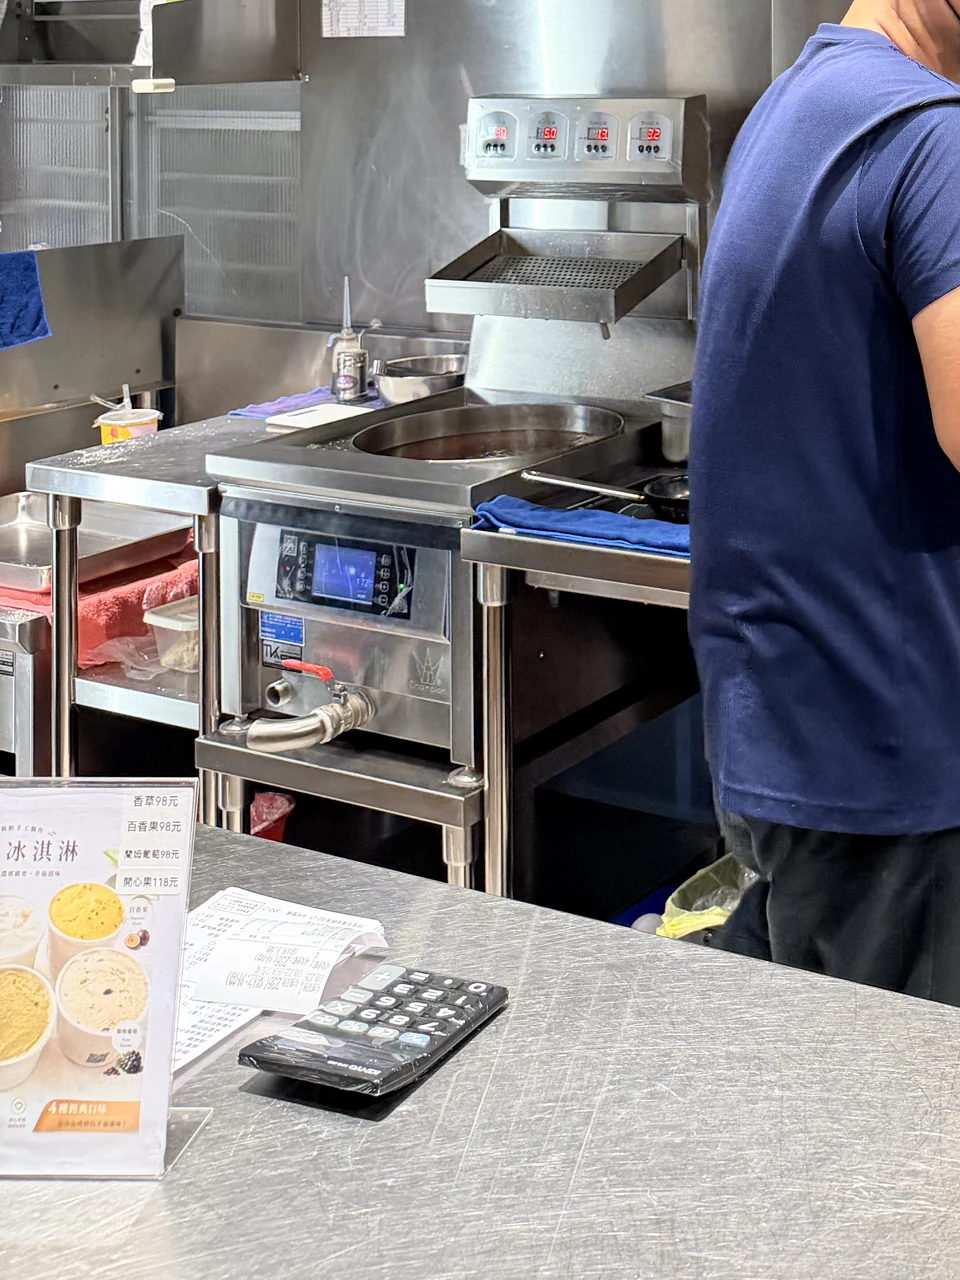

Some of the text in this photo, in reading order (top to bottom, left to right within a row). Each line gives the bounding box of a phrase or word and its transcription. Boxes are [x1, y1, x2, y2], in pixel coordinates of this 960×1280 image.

[133, 795, 179, 807] 香草98元
[127, 821, 182, 833] 百香果98元
[6, 840, 79, 862] 冰淇淋
[123, 876, 179, 888] 開心果118元
[348, 1063, 382, 1076] KINYO
